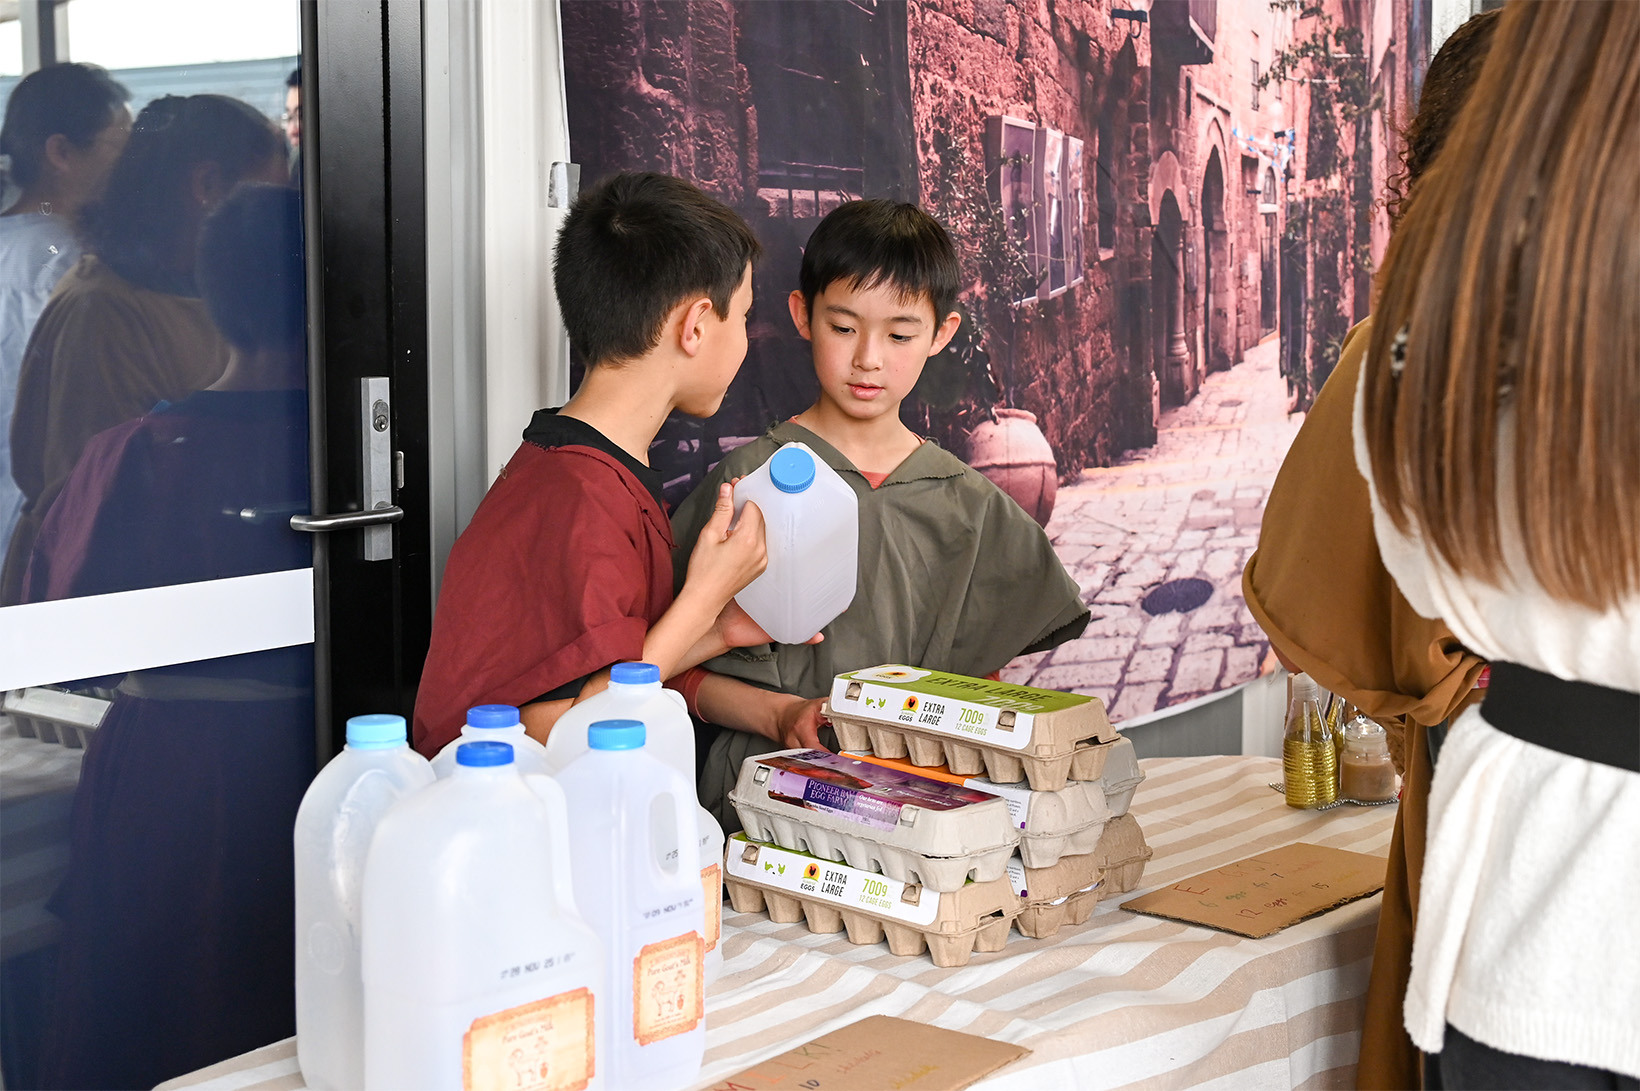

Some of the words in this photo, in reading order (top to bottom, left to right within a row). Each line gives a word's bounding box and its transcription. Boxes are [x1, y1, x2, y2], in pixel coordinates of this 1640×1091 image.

[926, 677, 989, 691] EXTRA
[984, 687, 1053, 702] LARGE
[923, 701, 946, 715] EXTRA
[898, 714, 914, 723] EGGS
[918, 714, 942, 726] LARGE
[958, 708, 984, 725] 700g
[955, 723, 962, 731] 12
[962, 724, 974, 734] CAGE
[975, 728, 988, 736] EGGS
[808, 780, 839, 796] PIONEER
[810, 790, 826, 801] EGG
[827, 794, 849, 806] FARM
[824, 870, 848, 886] EXTRA
[800, 882, 816, 893] EGGS
[820, 883, 845, 897] LARGE
[862, 878, 888, 897] 700g
[865, 896, 878, 906] CAGE
[878, 900, 892, 910] EGGS
[1235, 908, 1264, 920] 12
[1311, 882, 1330, 890] 15
[524, 961, 540, 974] NOV
[798, 1079, 820, 1091] 10
